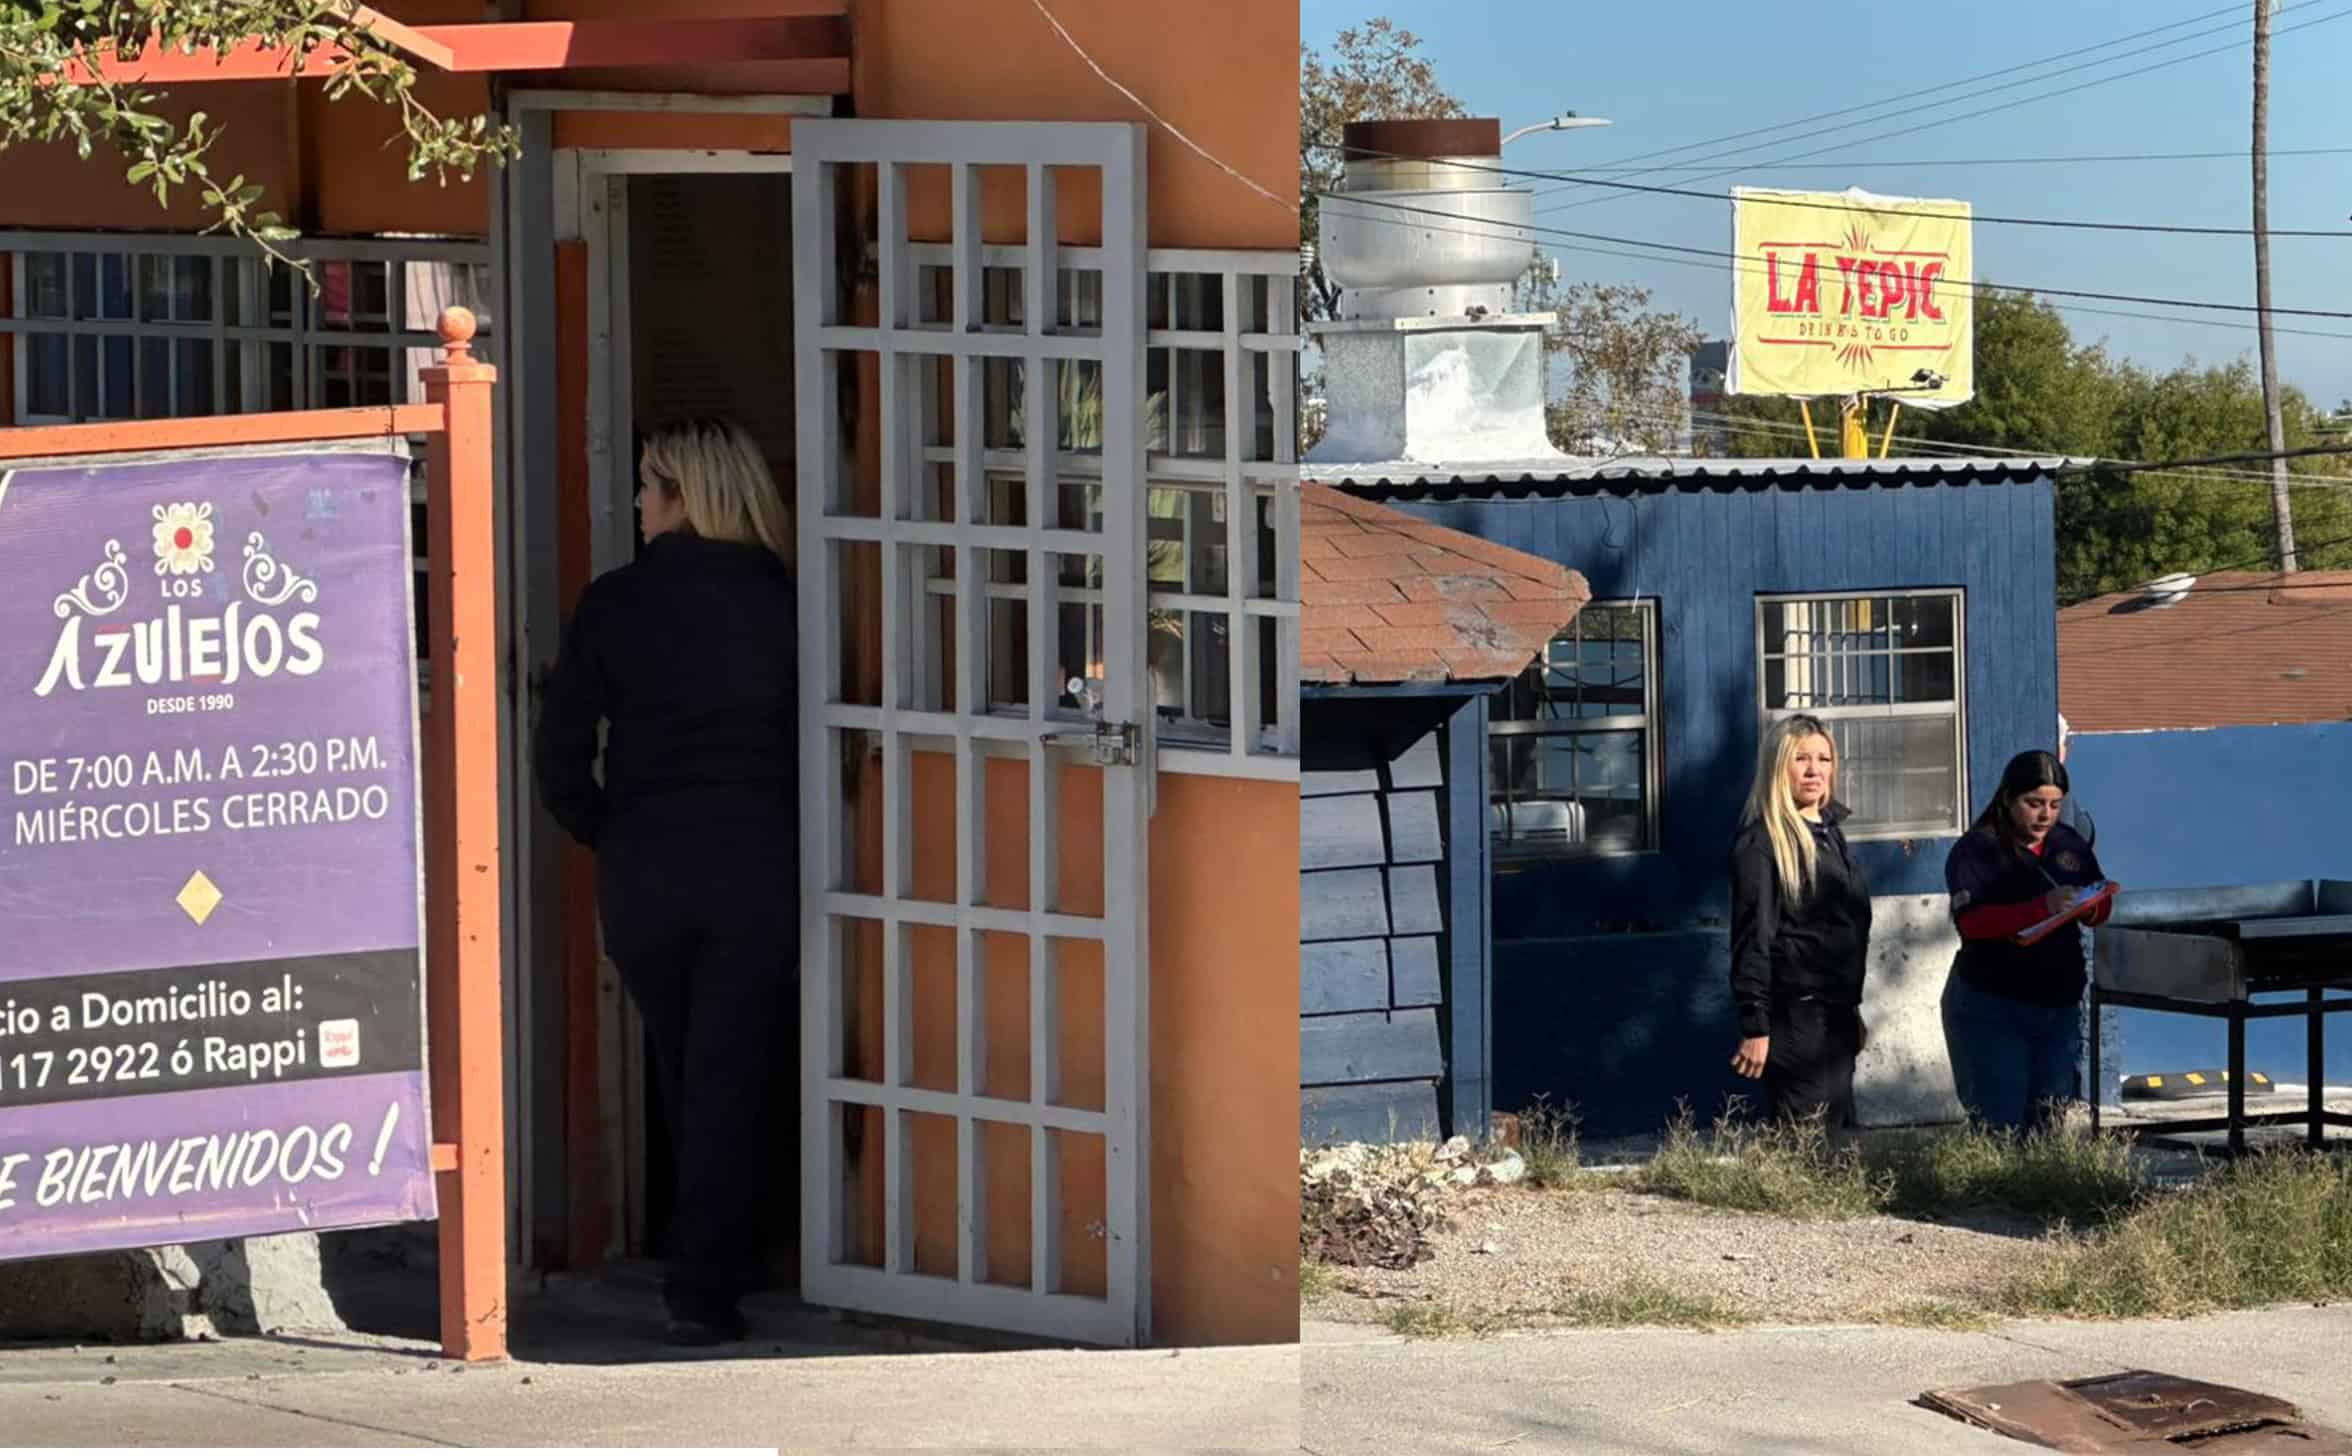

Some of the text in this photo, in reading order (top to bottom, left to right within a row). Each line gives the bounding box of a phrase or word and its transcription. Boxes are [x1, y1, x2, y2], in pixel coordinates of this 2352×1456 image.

[1766, 251, 1943, 319] LA TEPIC
[1865, 325, 1882, 341] TO
[1888, 327, 1909, 342] GO
[161, 578, 203, 598] LOS
[147, 693, 234, 714] DESDE 1990
[14, 735, 387, 795] DE 7:00 A.M. A 2:30 P.M.
[15, 785, 388, 845] MIÉRCOLES CERRADO
[50, 1005, 71, 1032] a
[82, 980, 251, 1029] Domicilio
[261, 973, 303, 1013] al:
[67, 1042, 161, 1085] 2922
[171, 1041, 193, 1075] ó
[204, 1029, 306, 1079] Rappi
[36, 1122, 353, 1208] BIENVENIDOS
